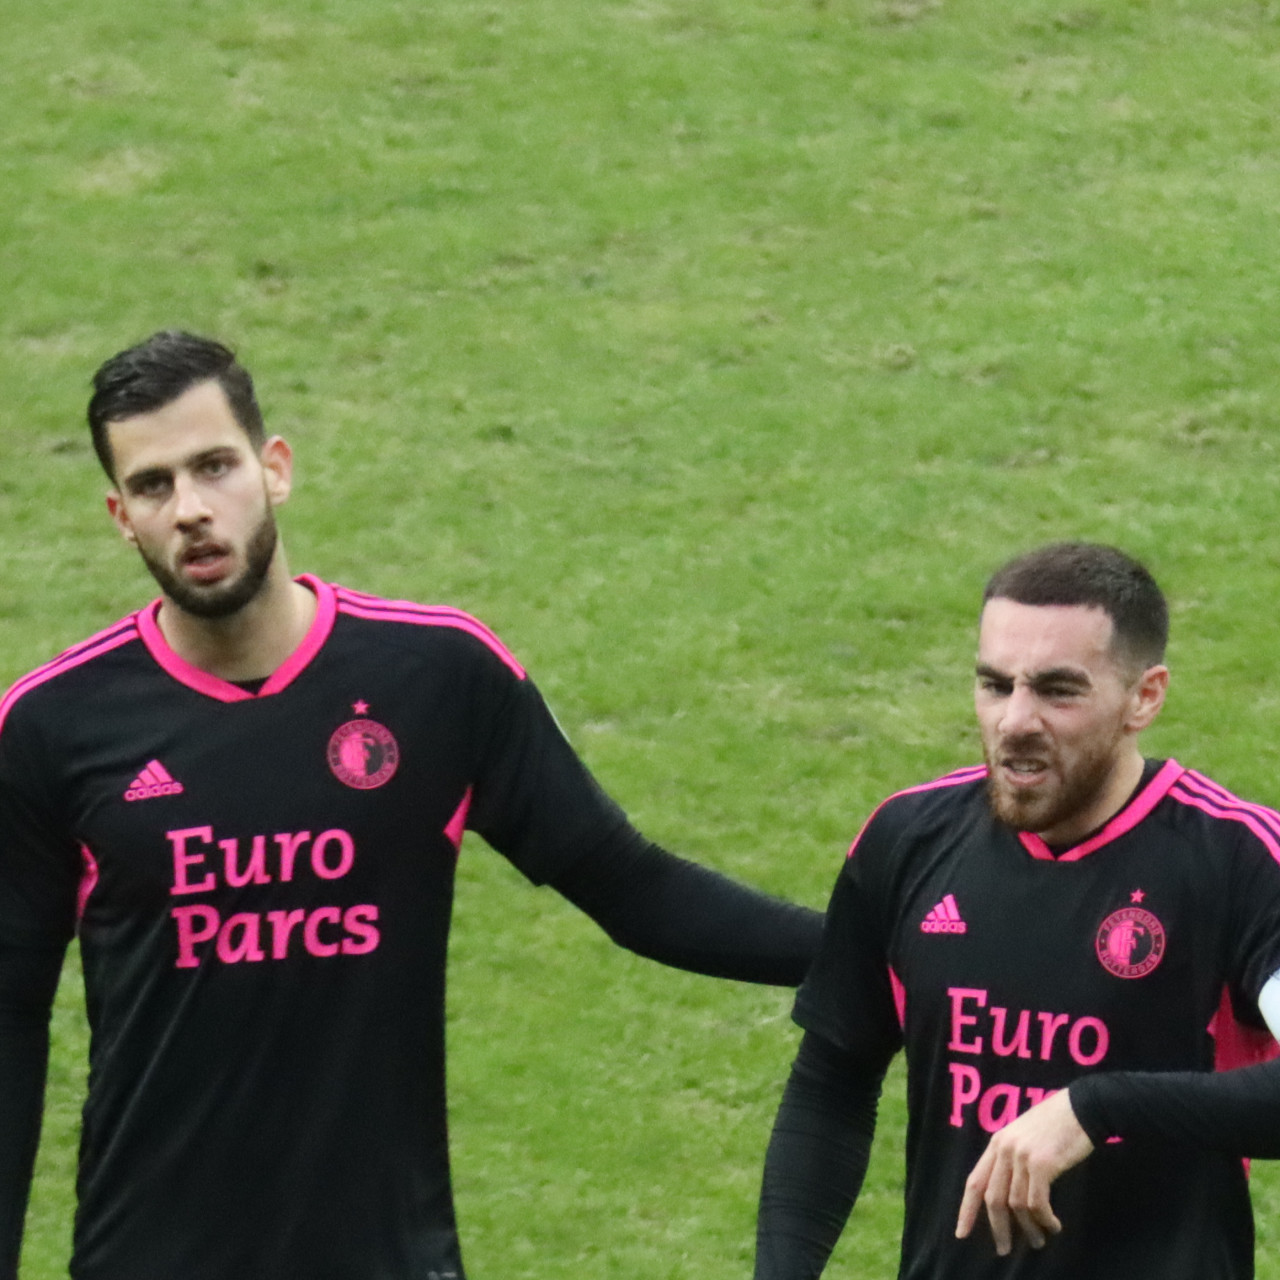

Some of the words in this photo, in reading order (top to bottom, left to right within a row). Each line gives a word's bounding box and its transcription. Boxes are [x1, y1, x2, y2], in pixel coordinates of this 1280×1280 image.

[124, 781, 184, 801] adidas
[166, 825, 355, 895] Euro
[171, 904, 381, 968] Parcs
[920, 920, 967, 934] adidas
[948, 986, 1110, 1065] Euro
